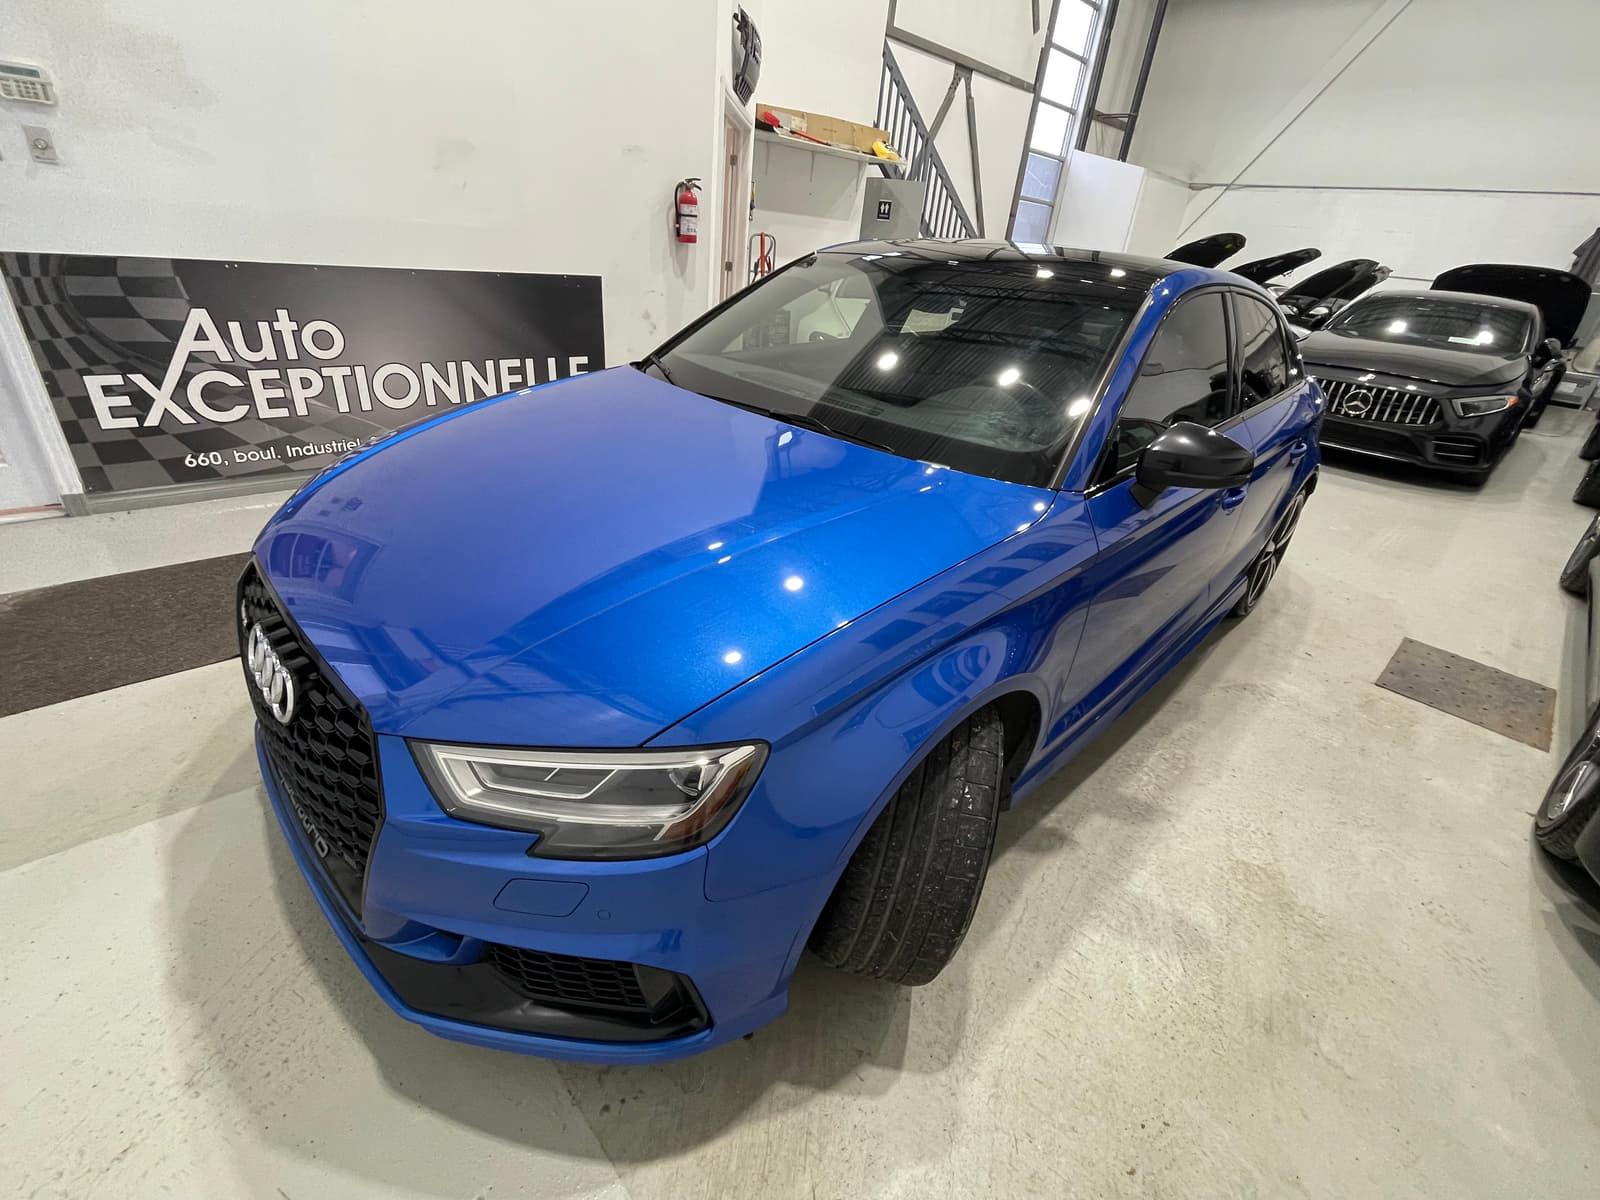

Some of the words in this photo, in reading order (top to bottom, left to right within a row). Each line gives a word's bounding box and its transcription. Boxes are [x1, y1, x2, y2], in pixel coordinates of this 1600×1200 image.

[174, 307, 346, 363] Auto
[184, 451, 229, 468] 660,
[233, 446, 282, 463] boul.
